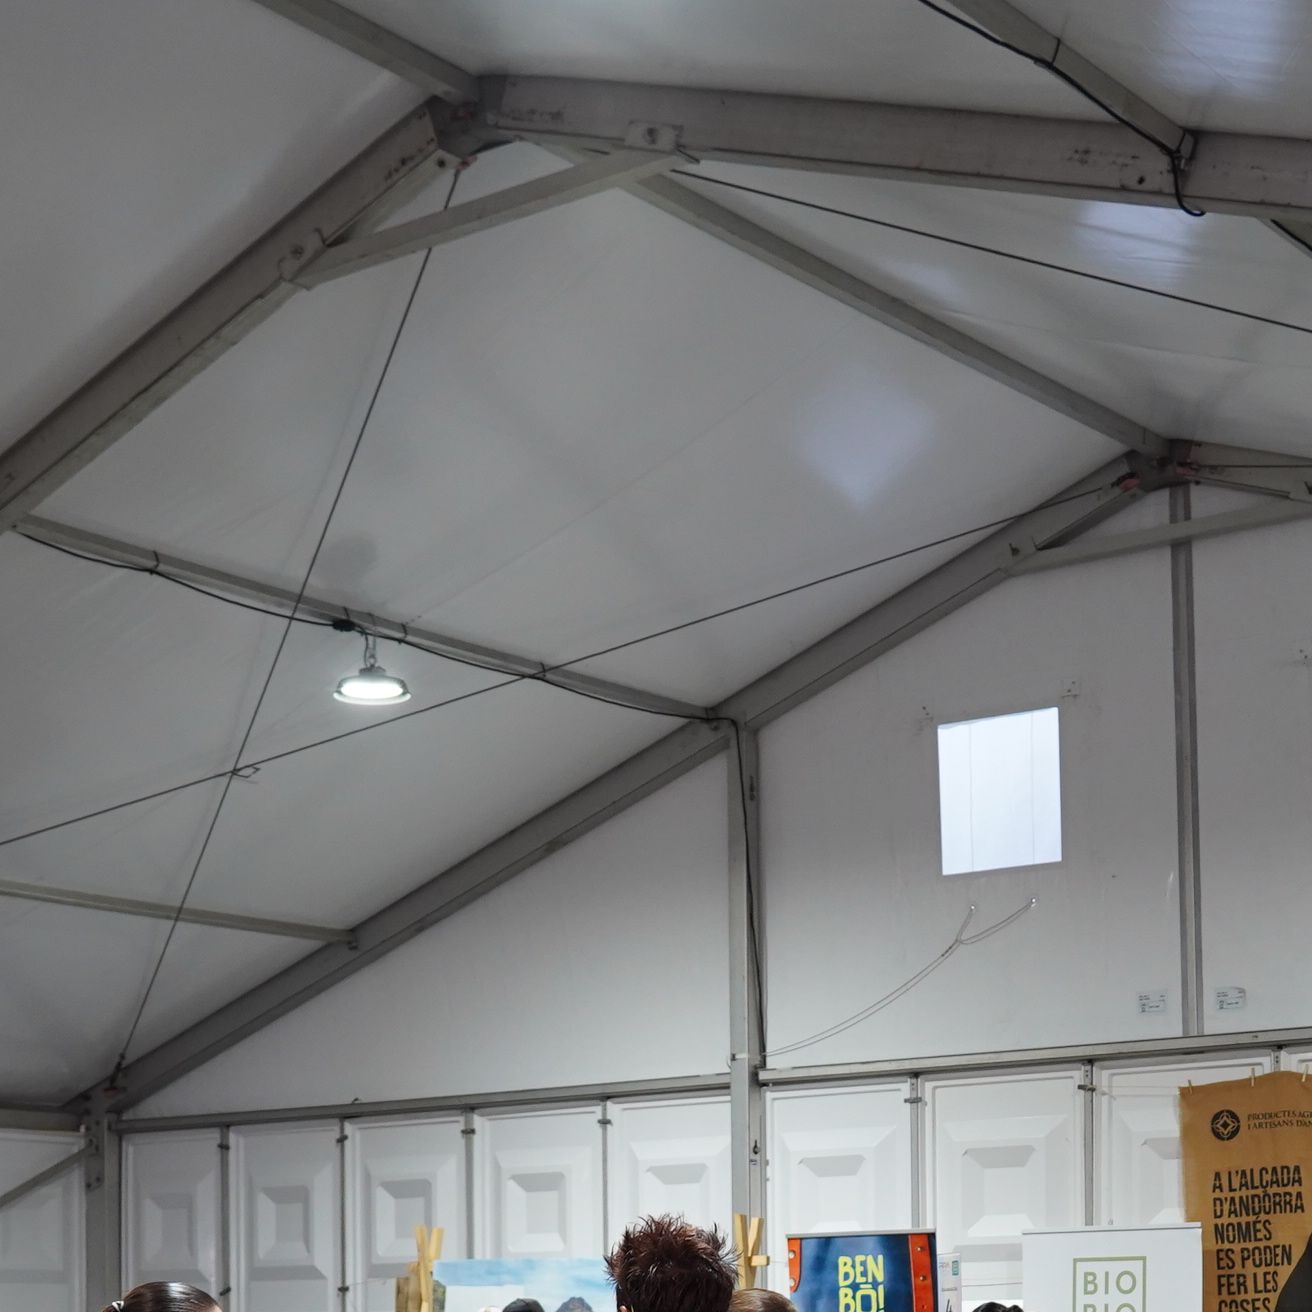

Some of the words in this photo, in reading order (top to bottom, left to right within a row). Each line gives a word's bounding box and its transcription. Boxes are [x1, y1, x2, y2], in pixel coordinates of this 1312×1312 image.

[1212, 1171, 1224, 1193] A
[1228, 1165, 1303, 1194] L'ALÇADA
[1213, 1191, 1305, 1219] D'ANDORRA
[1214, 1216, 1273, 1245] NOMÉS
[838, 1254, 885, 1287] BEN
[1216, 1248, 1236, 1270] ES
[1241, 1244, 1293, 1269] PODEN
[1083, 1270, 1137, 1295] BIO
[1217, 1273, 1248, 1296] FER
[1253, 1271, 1279, 1294] LES
